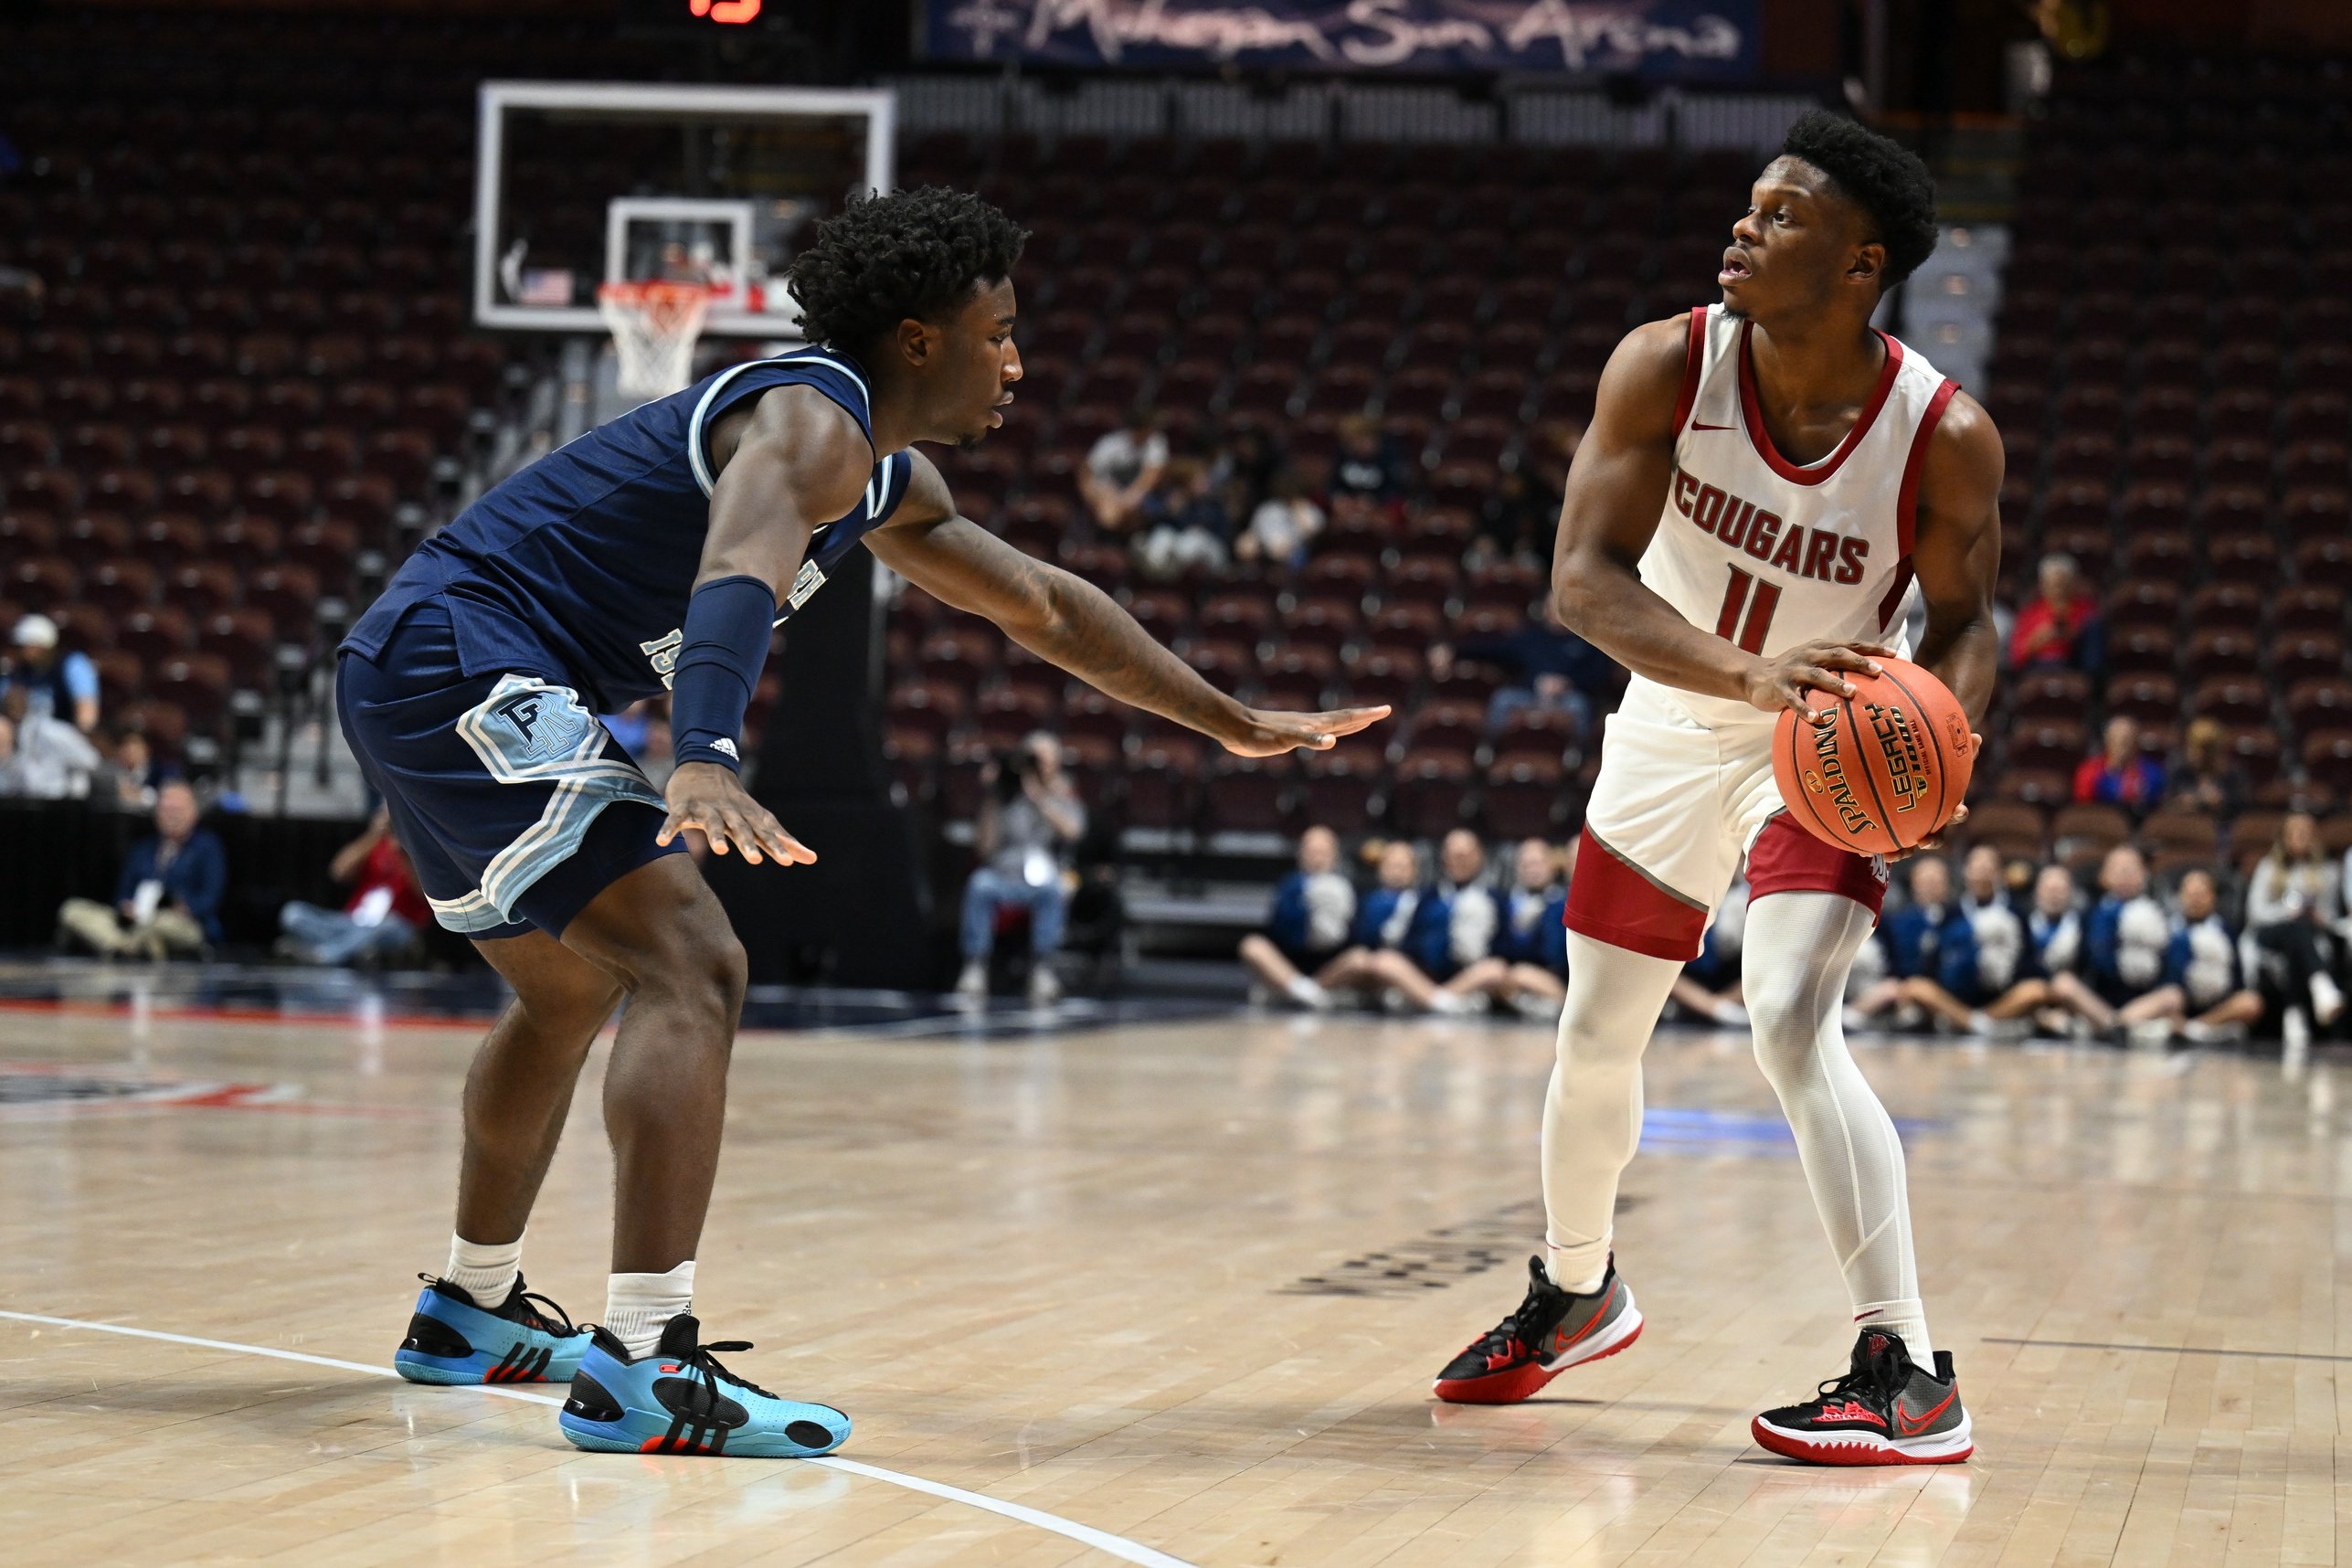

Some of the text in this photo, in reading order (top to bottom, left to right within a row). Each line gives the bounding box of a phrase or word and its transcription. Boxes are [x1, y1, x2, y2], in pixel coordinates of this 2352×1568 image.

[1341, 0, 1494, 66] Sun
[1503, 0, 1743, 71] Arena
[1675, 467, 1870, 586] COUGARS
[1716, 563, 1783, 656] 11
[1814, 707, 1879, 835] SPALDING
[1863, 703, 1917, 813] LEGACY
[1889, 706, 1922, 773] 1000
[1920, 750, 1933, 776] OFFICIAL
